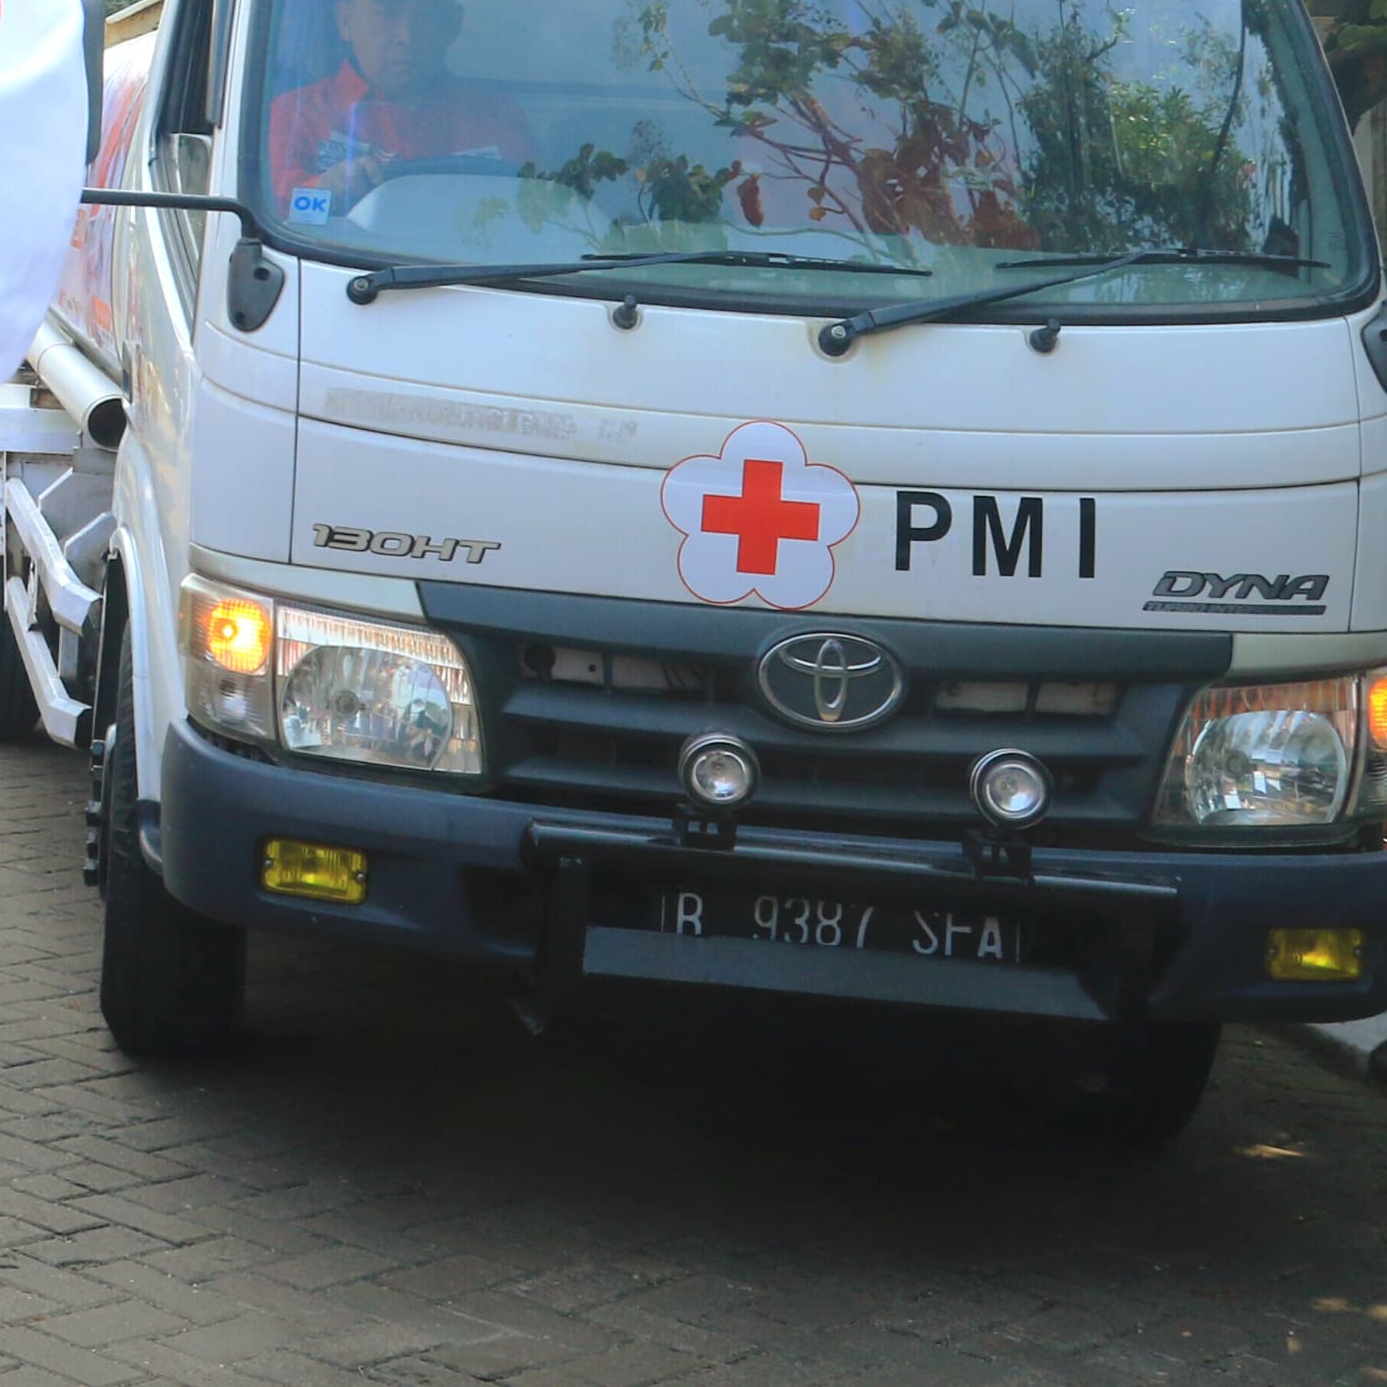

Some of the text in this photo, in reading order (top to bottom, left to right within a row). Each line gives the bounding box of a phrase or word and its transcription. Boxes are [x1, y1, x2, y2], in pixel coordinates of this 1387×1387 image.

[294, 196, 327, 212] OK
[313, 523, 501, 564] 130HT
[895, 491, 1095, 578] PMI
[1152, 571, 1330, 601] DYNA
[753, 895, 875, 948] 9387
